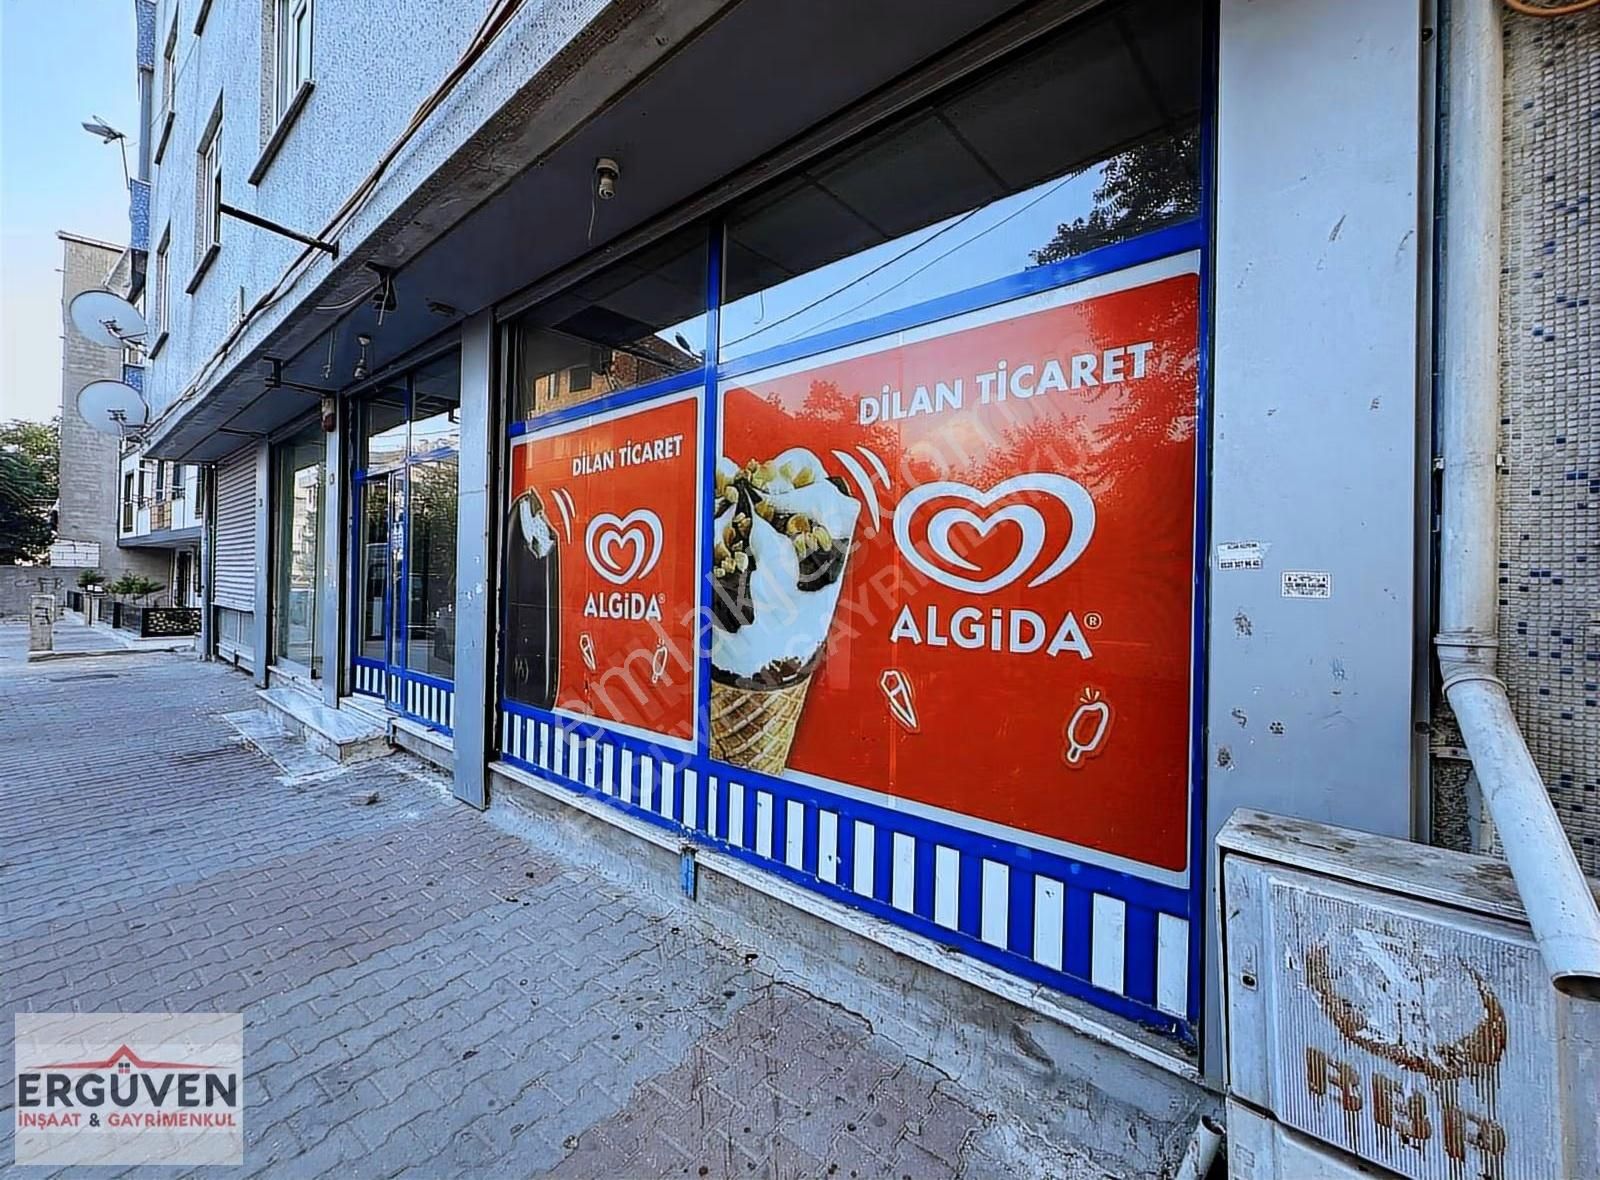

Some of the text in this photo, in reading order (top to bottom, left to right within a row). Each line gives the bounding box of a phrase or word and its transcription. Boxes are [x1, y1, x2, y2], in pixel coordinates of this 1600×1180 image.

[860, 341, 1154, 425] DİLAN TİCARET
[572, 435, 683, 476] DİLAN TİCARET
